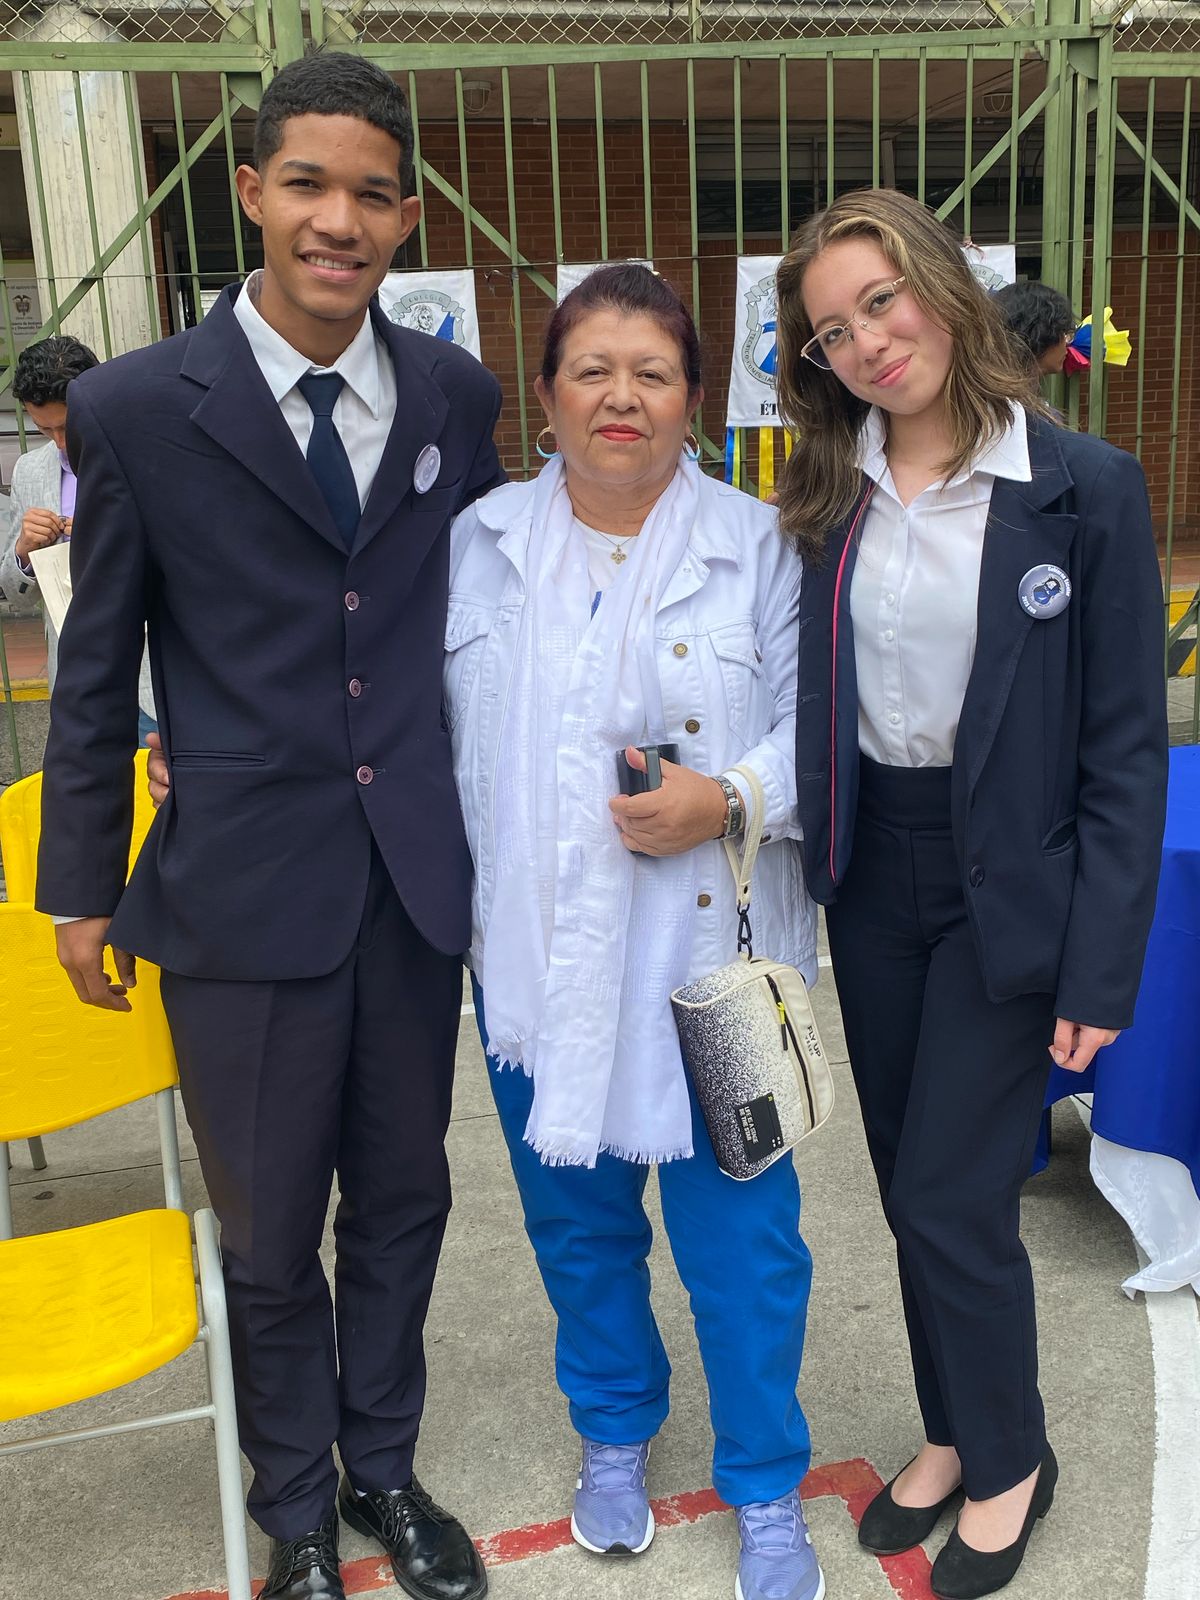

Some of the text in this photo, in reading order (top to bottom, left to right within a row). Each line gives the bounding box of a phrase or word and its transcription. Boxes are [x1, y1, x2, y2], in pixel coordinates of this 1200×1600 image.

[760, 400, 777, 416] ÉT
[807, 1025, 821, 1057] FLY UP
[741, 1116, 749, 1127] THE
[744, 1127, 752, 1141] STAR
